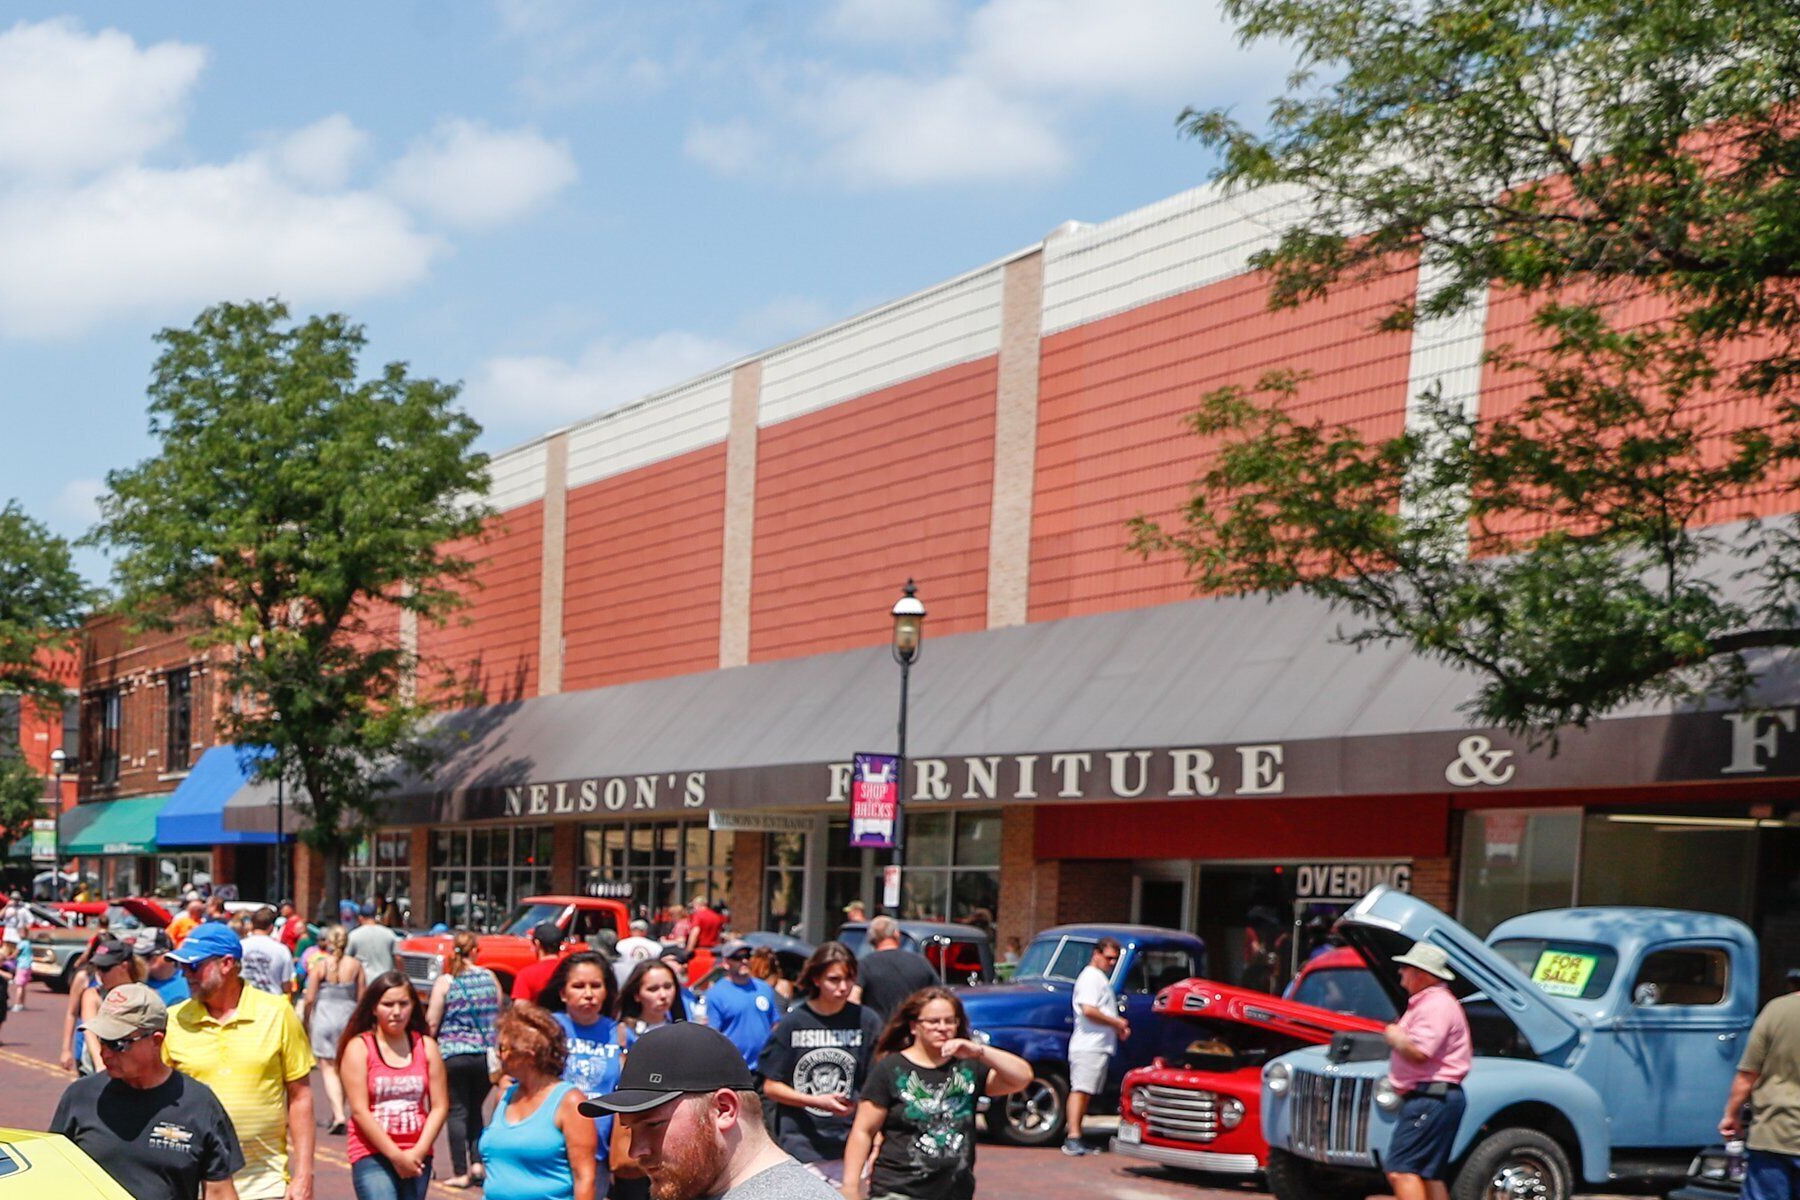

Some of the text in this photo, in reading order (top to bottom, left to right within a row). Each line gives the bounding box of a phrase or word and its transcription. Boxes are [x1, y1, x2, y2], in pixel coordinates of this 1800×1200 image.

[503, 772, 706, 816] NELSON'S
[826, 745, 1285, 802] FRNITURE
[1445, 735, 1515, 786] &
[860, 783, 888, 799] SHOP
[854, 801, 894, 818] BRICKS
[1553, 954, 1582, 969] FOR
[1541, 968, 1580, 984] SALE
[149, 1138, 191, 1153] DETROIT
